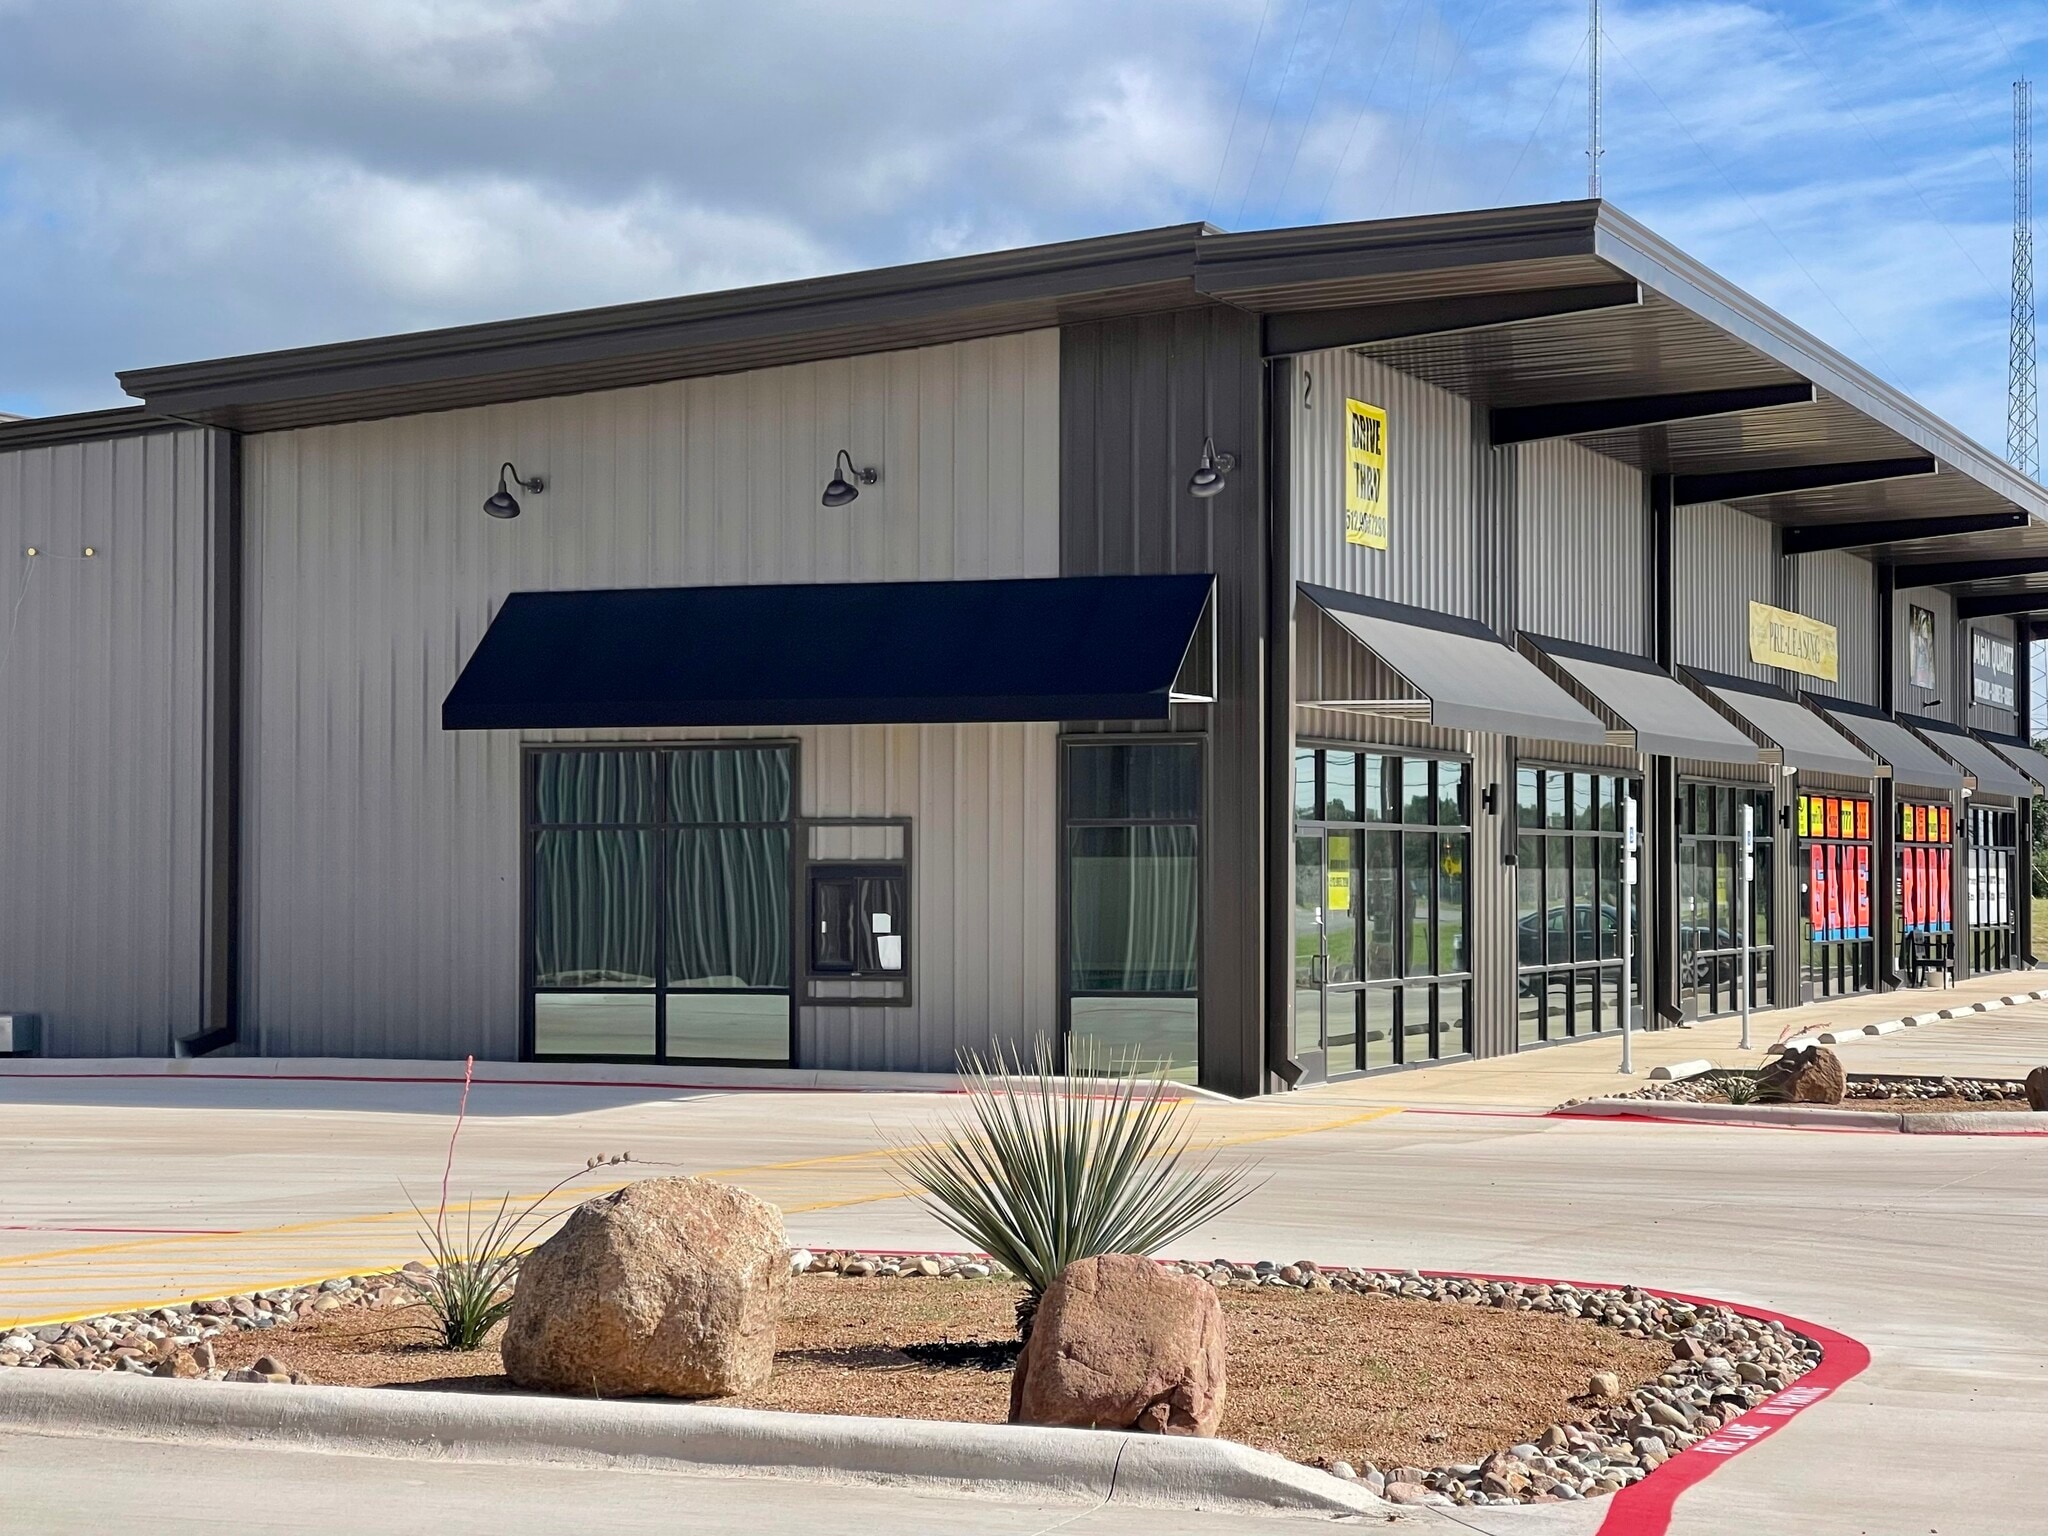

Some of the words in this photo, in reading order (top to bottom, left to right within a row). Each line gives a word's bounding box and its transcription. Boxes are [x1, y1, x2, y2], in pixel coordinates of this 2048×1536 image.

[1304, 369, 1312, 410] 2
[1352, 412, 1381, 456] DRIVE
[1353, 461, 1381, 504] THRU
[1769, 620, 1821, 665] PRE-LEASING
[1992, 639, 2014, 677] QUARTZ
[1811, 844, 1869, 931] GAME
[1903, 847, 1951, 926] ROOM
